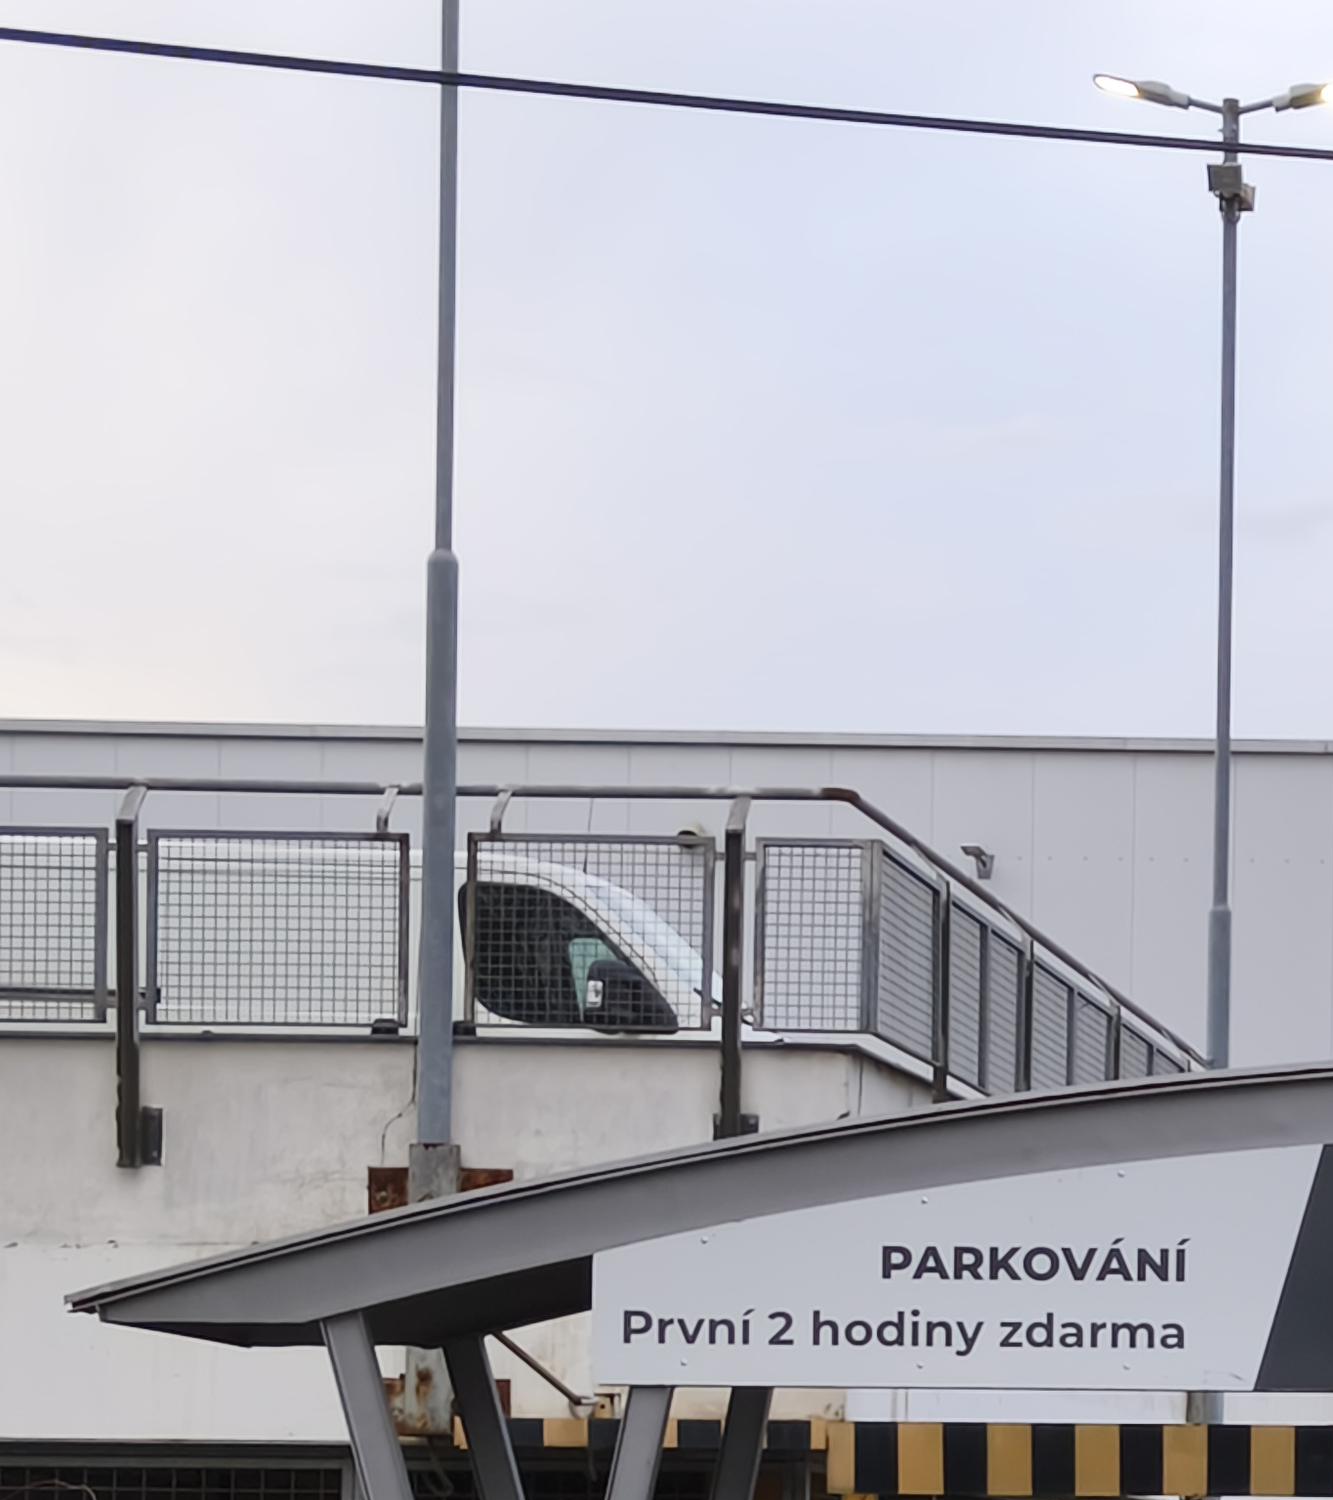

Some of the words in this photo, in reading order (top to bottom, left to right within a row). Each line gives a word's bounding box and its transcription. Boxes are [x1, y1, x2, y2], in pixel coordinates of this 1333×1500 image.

[881, 1238, 1191, 1282] PARKOVÁNÍ
[622, 1309, 756, 1346] První
[768, 1312, 794, 1346] 2
[812, 1309, 982, 1356] hodiny
[999, 1314, 1186, 1349] zdarma
